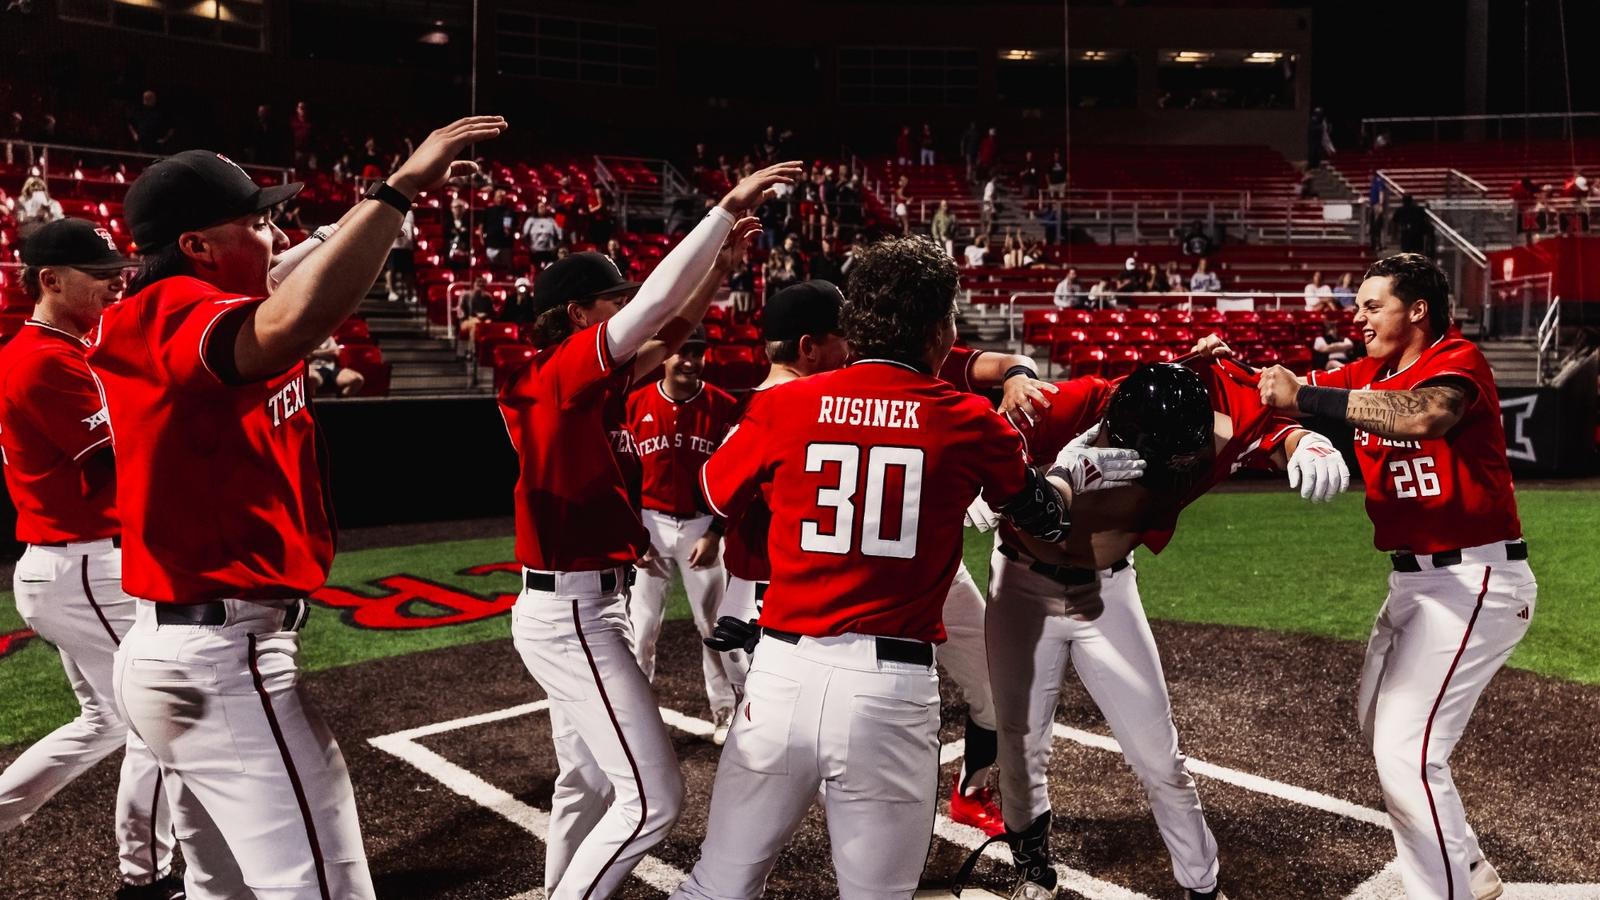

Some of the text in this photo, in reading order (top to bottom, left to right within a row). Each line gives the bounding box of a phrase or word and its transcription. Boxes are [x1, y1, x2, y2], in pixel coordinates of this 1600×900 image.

[268, 374, 306, 427] TEX
[818, 395, 921, 429] RUSINEK
[608, 429, 639, 456] TEX
[690, 435, 716, 455] TEC
[1389, 455, 1441, 499] 26
[800, 443, 925, 559] 30
